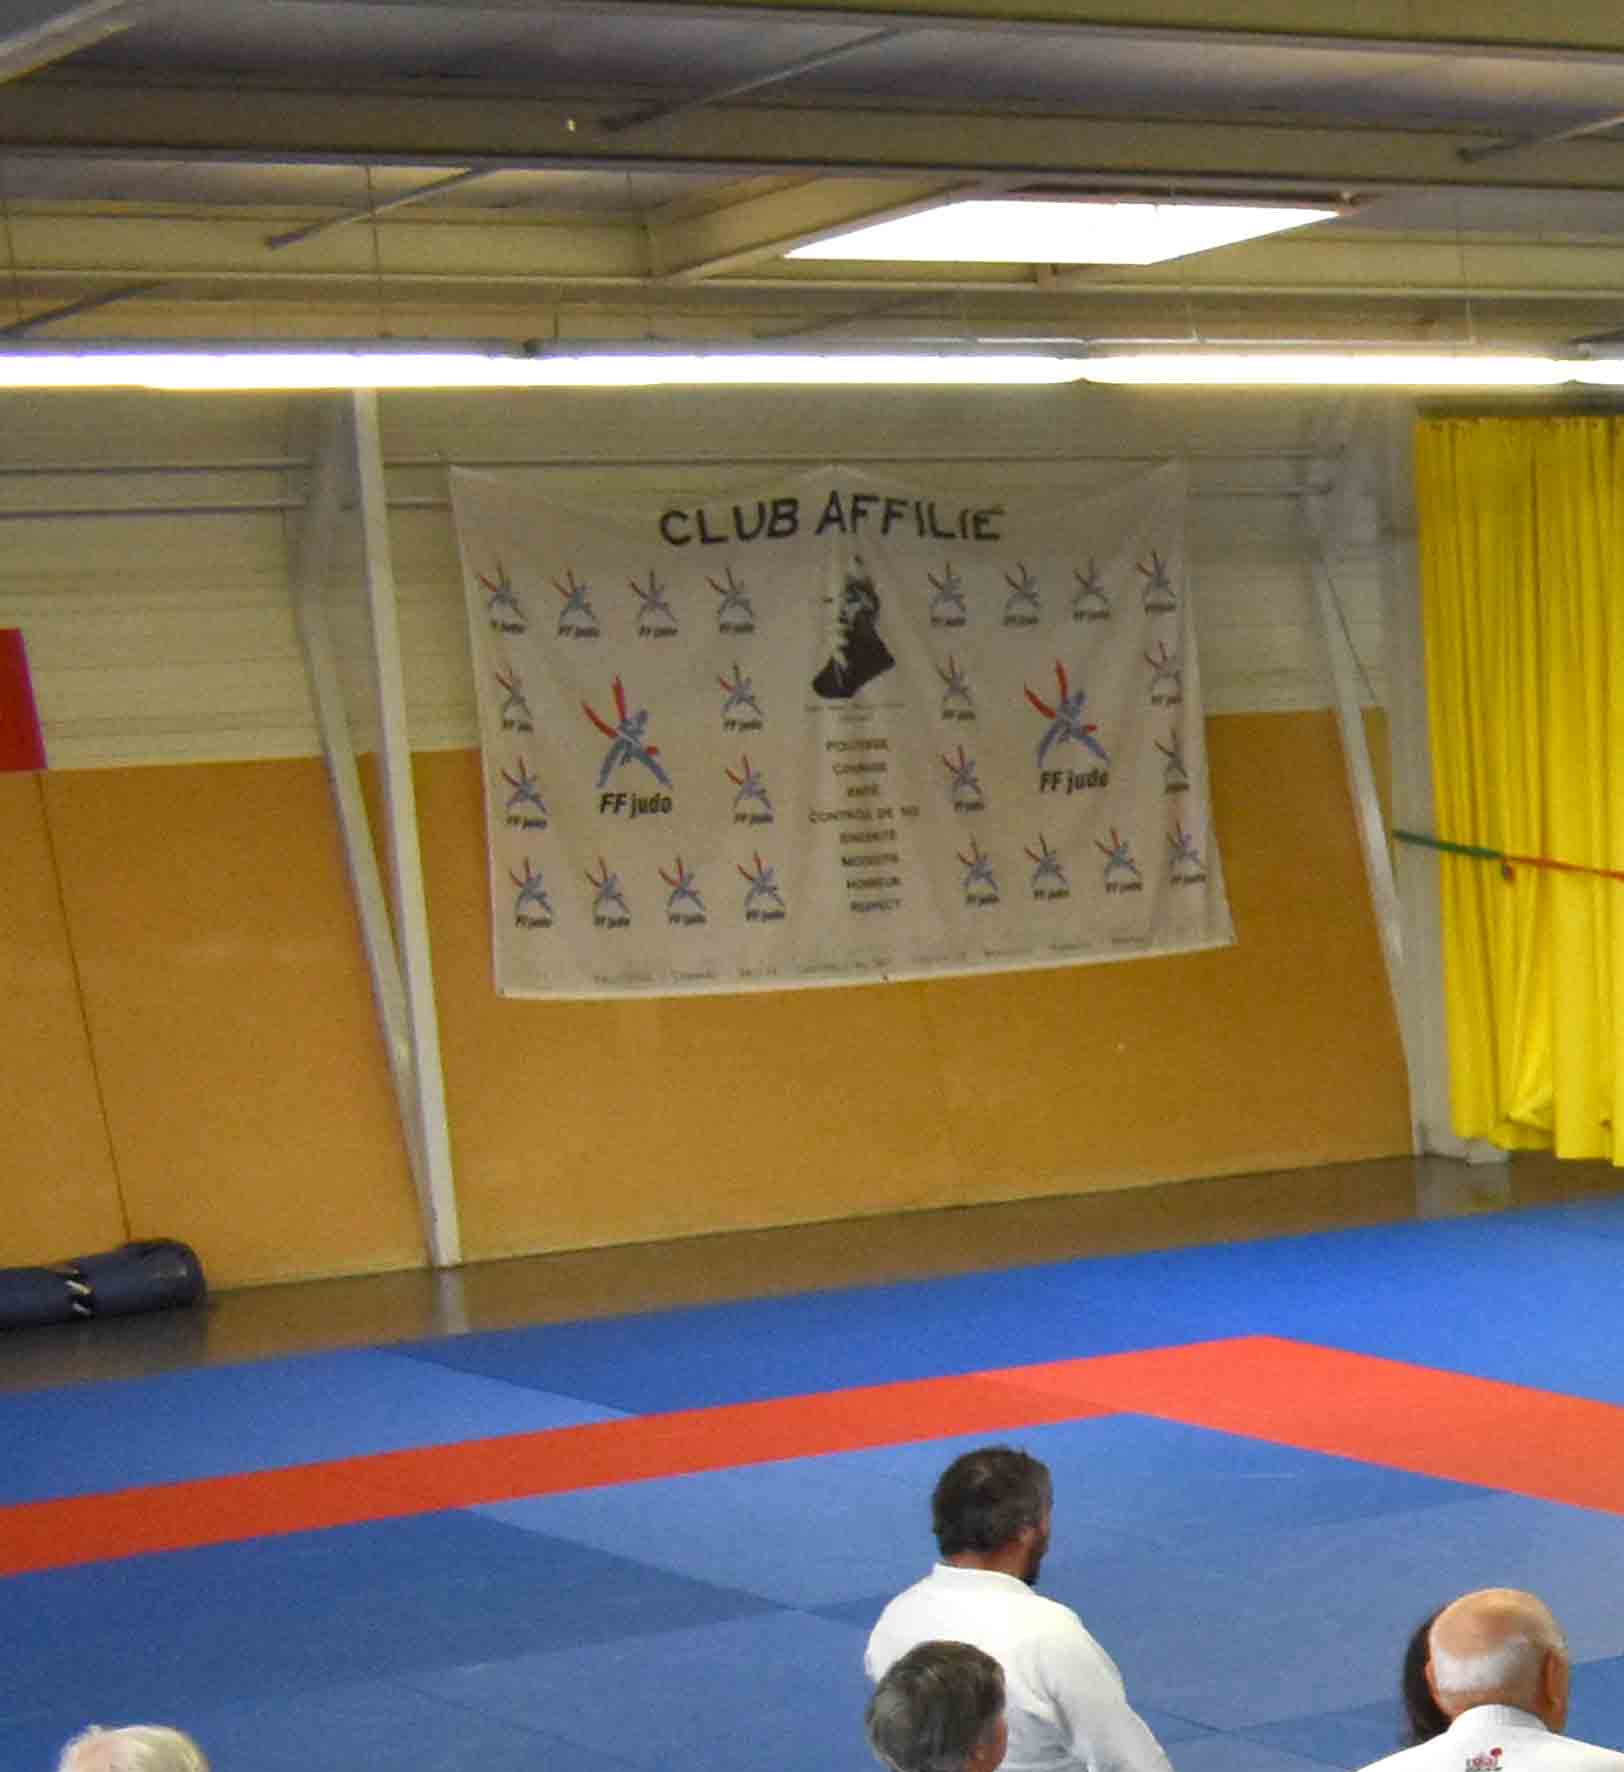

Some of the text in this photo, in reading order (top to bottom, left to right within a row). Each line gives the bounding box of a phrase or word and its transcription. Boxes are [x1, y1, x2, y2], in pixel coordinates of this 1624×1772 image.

[659, 498, 800, 546] CLUB
[1040, 767, 1110, 795] FF judo
[600, 793, 673, 819] FF judo
